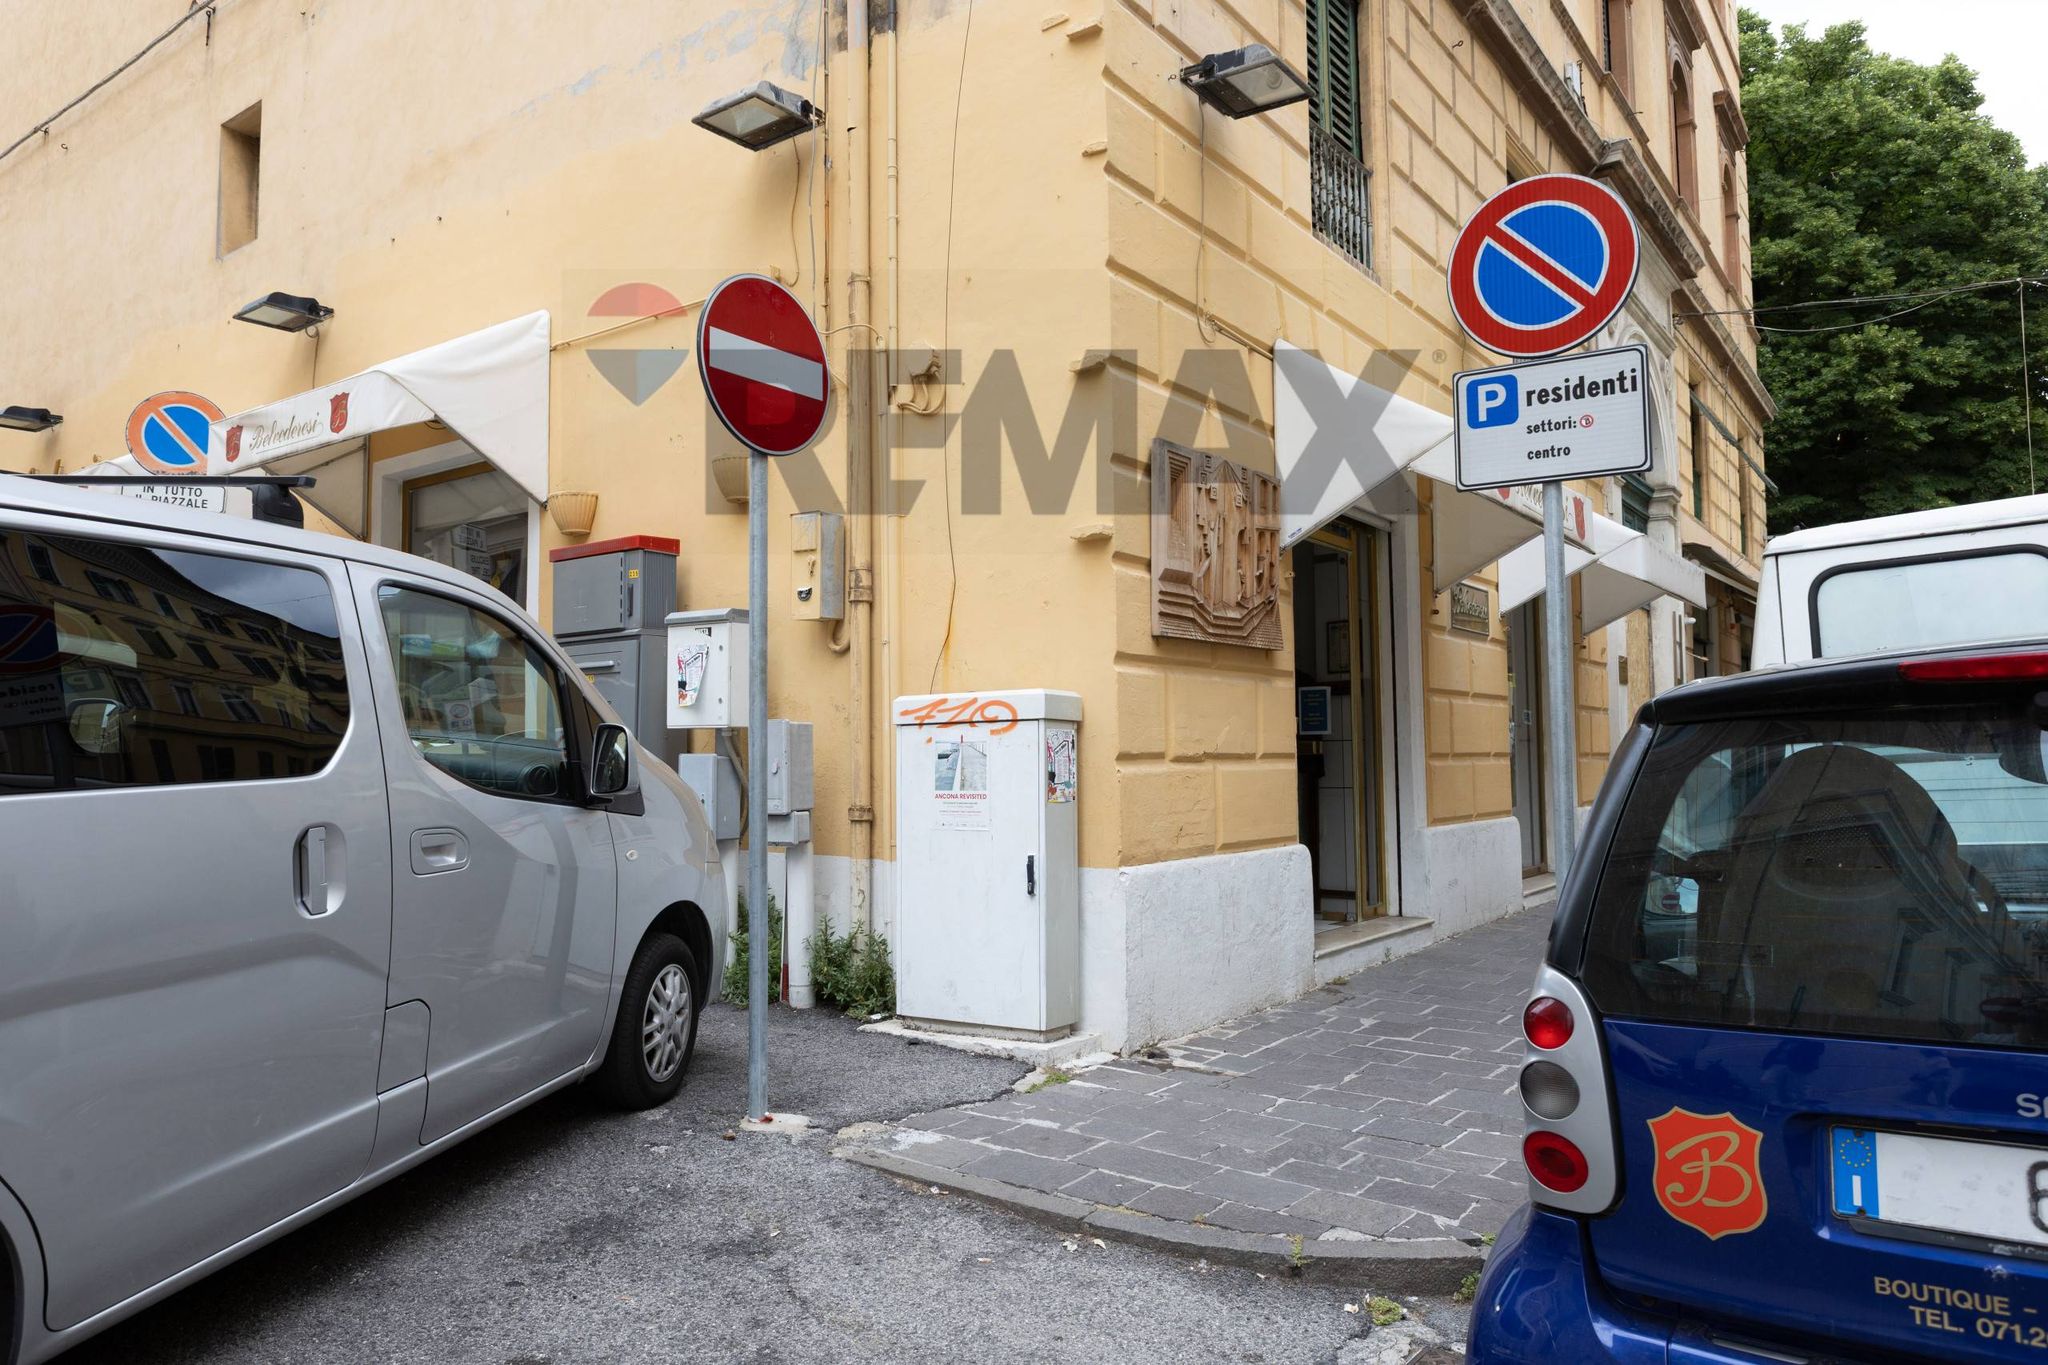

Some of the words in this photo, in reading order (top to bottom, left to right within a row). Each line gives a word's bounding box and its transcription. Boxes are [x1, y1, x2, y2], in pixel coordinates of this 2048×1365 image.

[1477, 383, 1507, 422] P
[1526, 367, 1638, 407] residenti
[1526, 416, 1577, 434] settori:
[1527, 444, 1571, 460] centro
[142, 485, 155, 493] IN
[164, 485, 203, 498] TUTTO
[1665, 1131, 1752, 1208] B
[1874, 1276, 2011, 1316] BOUTIQUE
[1908, 1305, 1965, 1333] TEL.
[1975, 1317, 2048, 1349] 071.2
